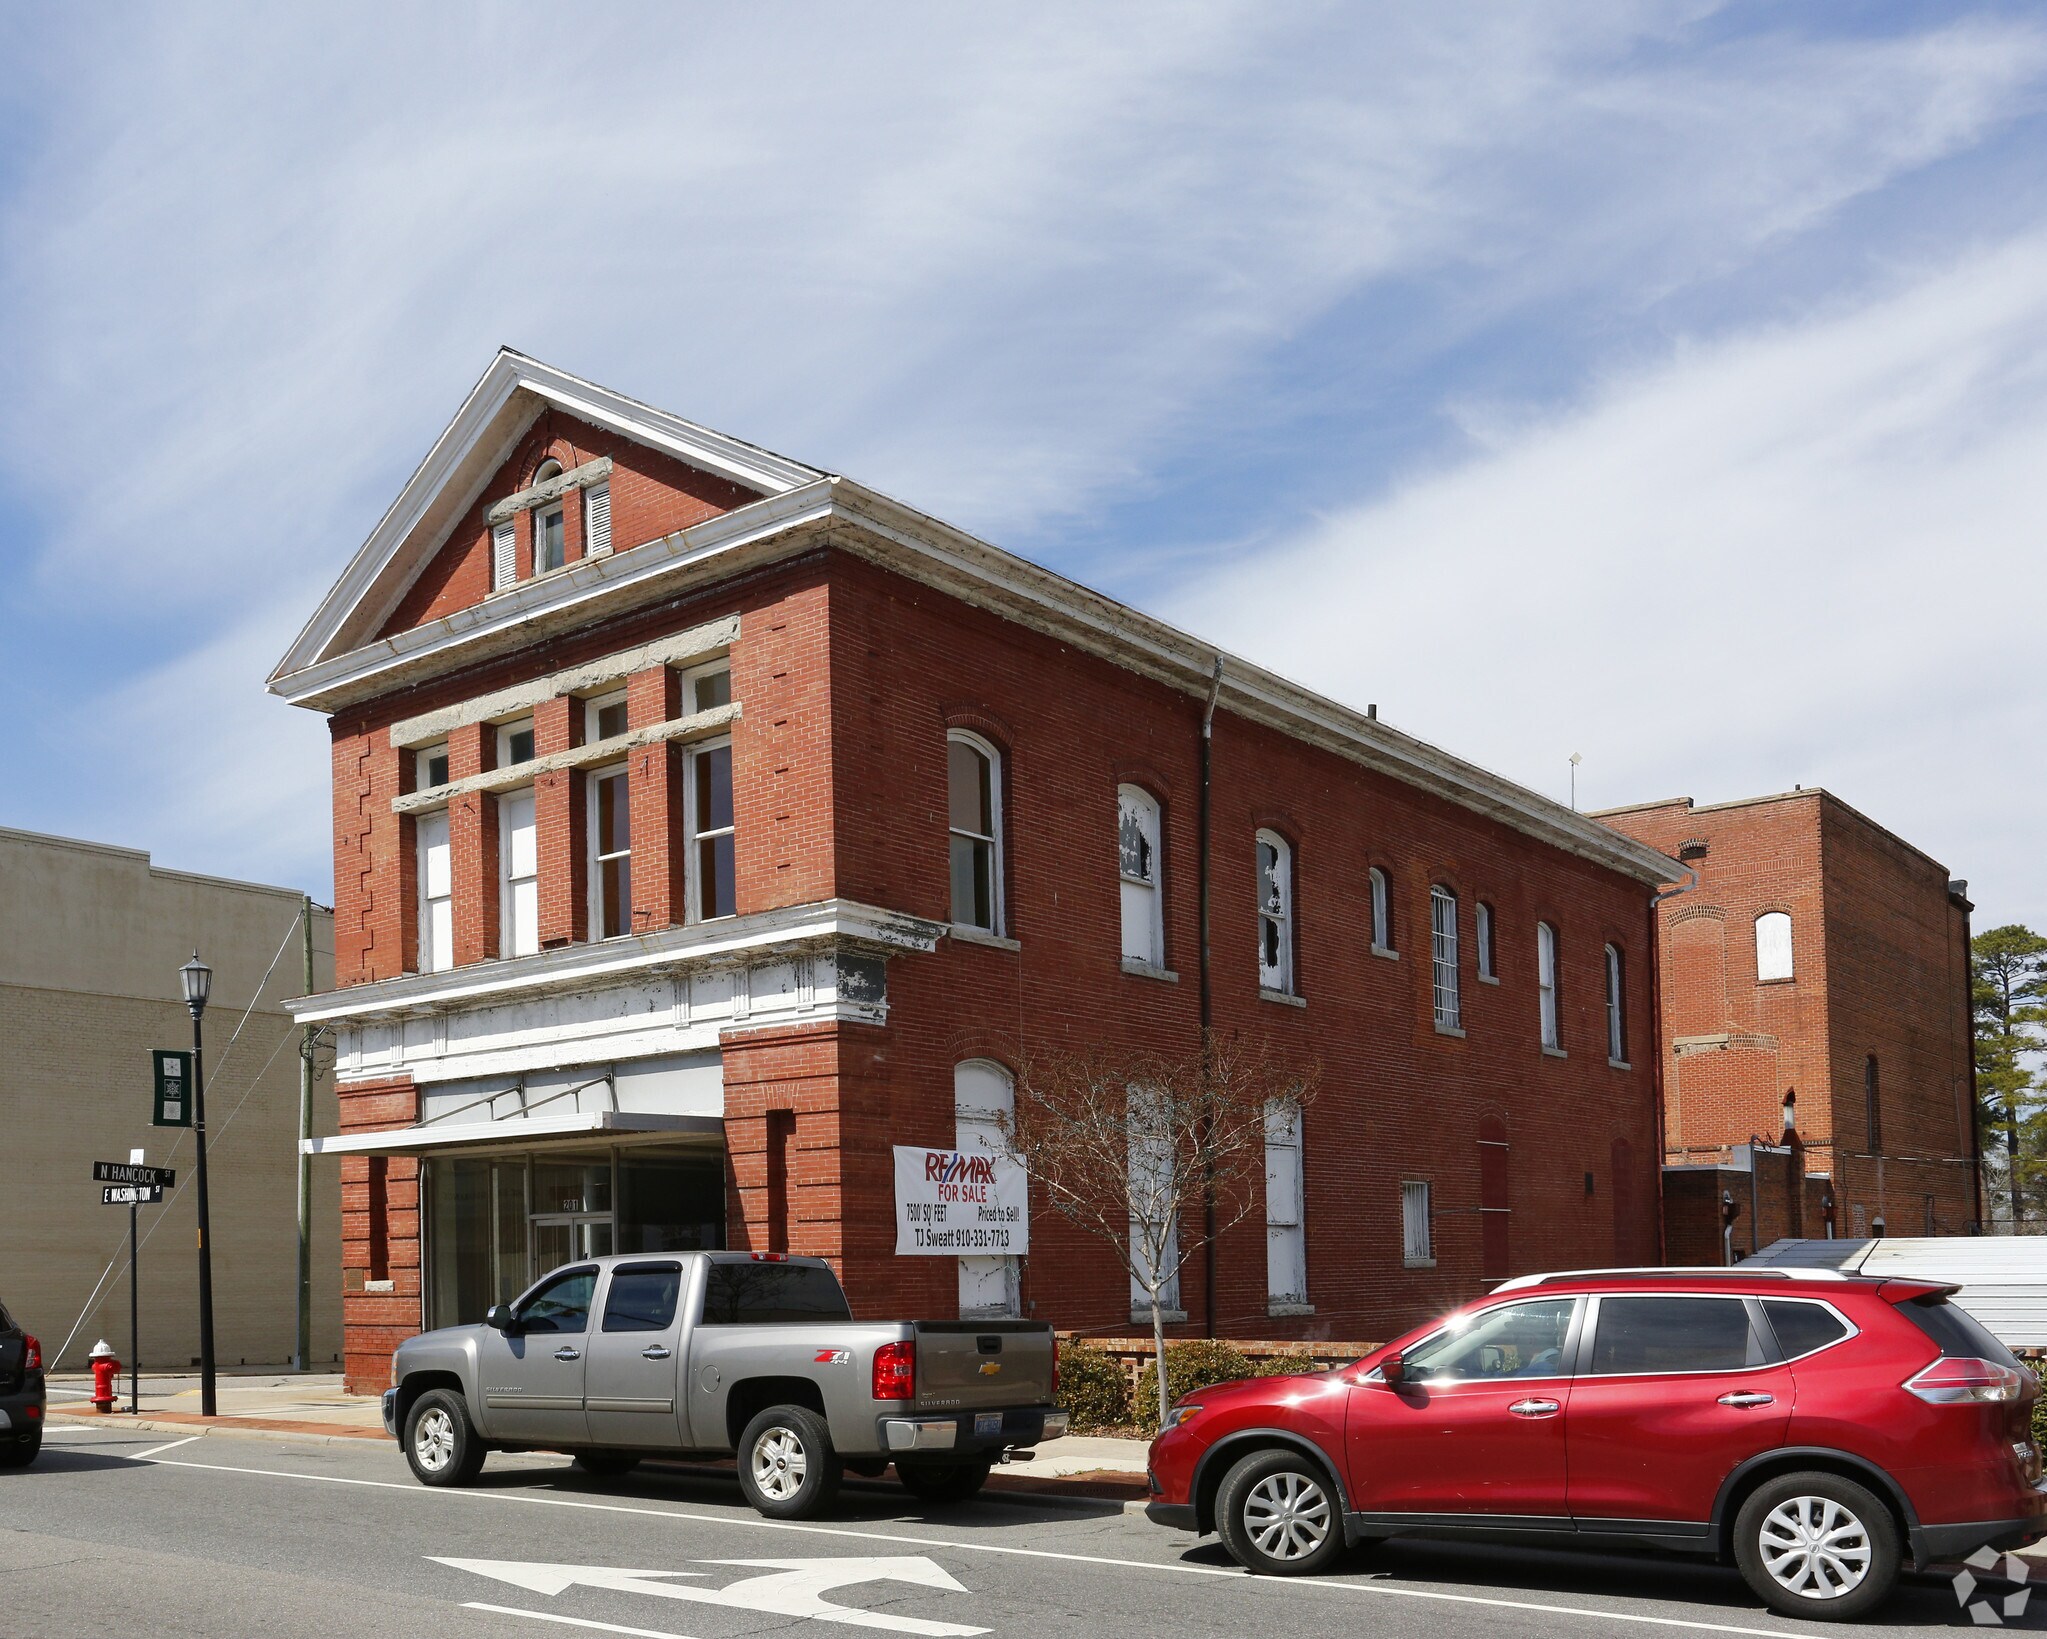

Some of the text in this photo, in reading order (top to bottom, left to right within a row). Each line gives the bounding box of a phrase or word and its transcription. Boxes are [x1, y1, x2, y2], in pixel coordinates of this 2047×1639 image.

[101, 1164, 108, 1178] N
[111, 1166, 157, 1184] HANCOCK
[925, 1152, 996, 1184] RE/MAX
[104, 1188, 110, 1202] E
[111, 1187, 151, 1202] WASHINGTON
[938, 1184, 987, 1203] FOR SALE
[563, 1199, 579, 1211] 201
[934, 1204, 947, 1222] FEET
[978, 1205, 997, 1222] Priced
[997, 1206, 1005, 1222] to
[914, 1228, 1010, 1247] TJ Sweatt 910-331-7713
